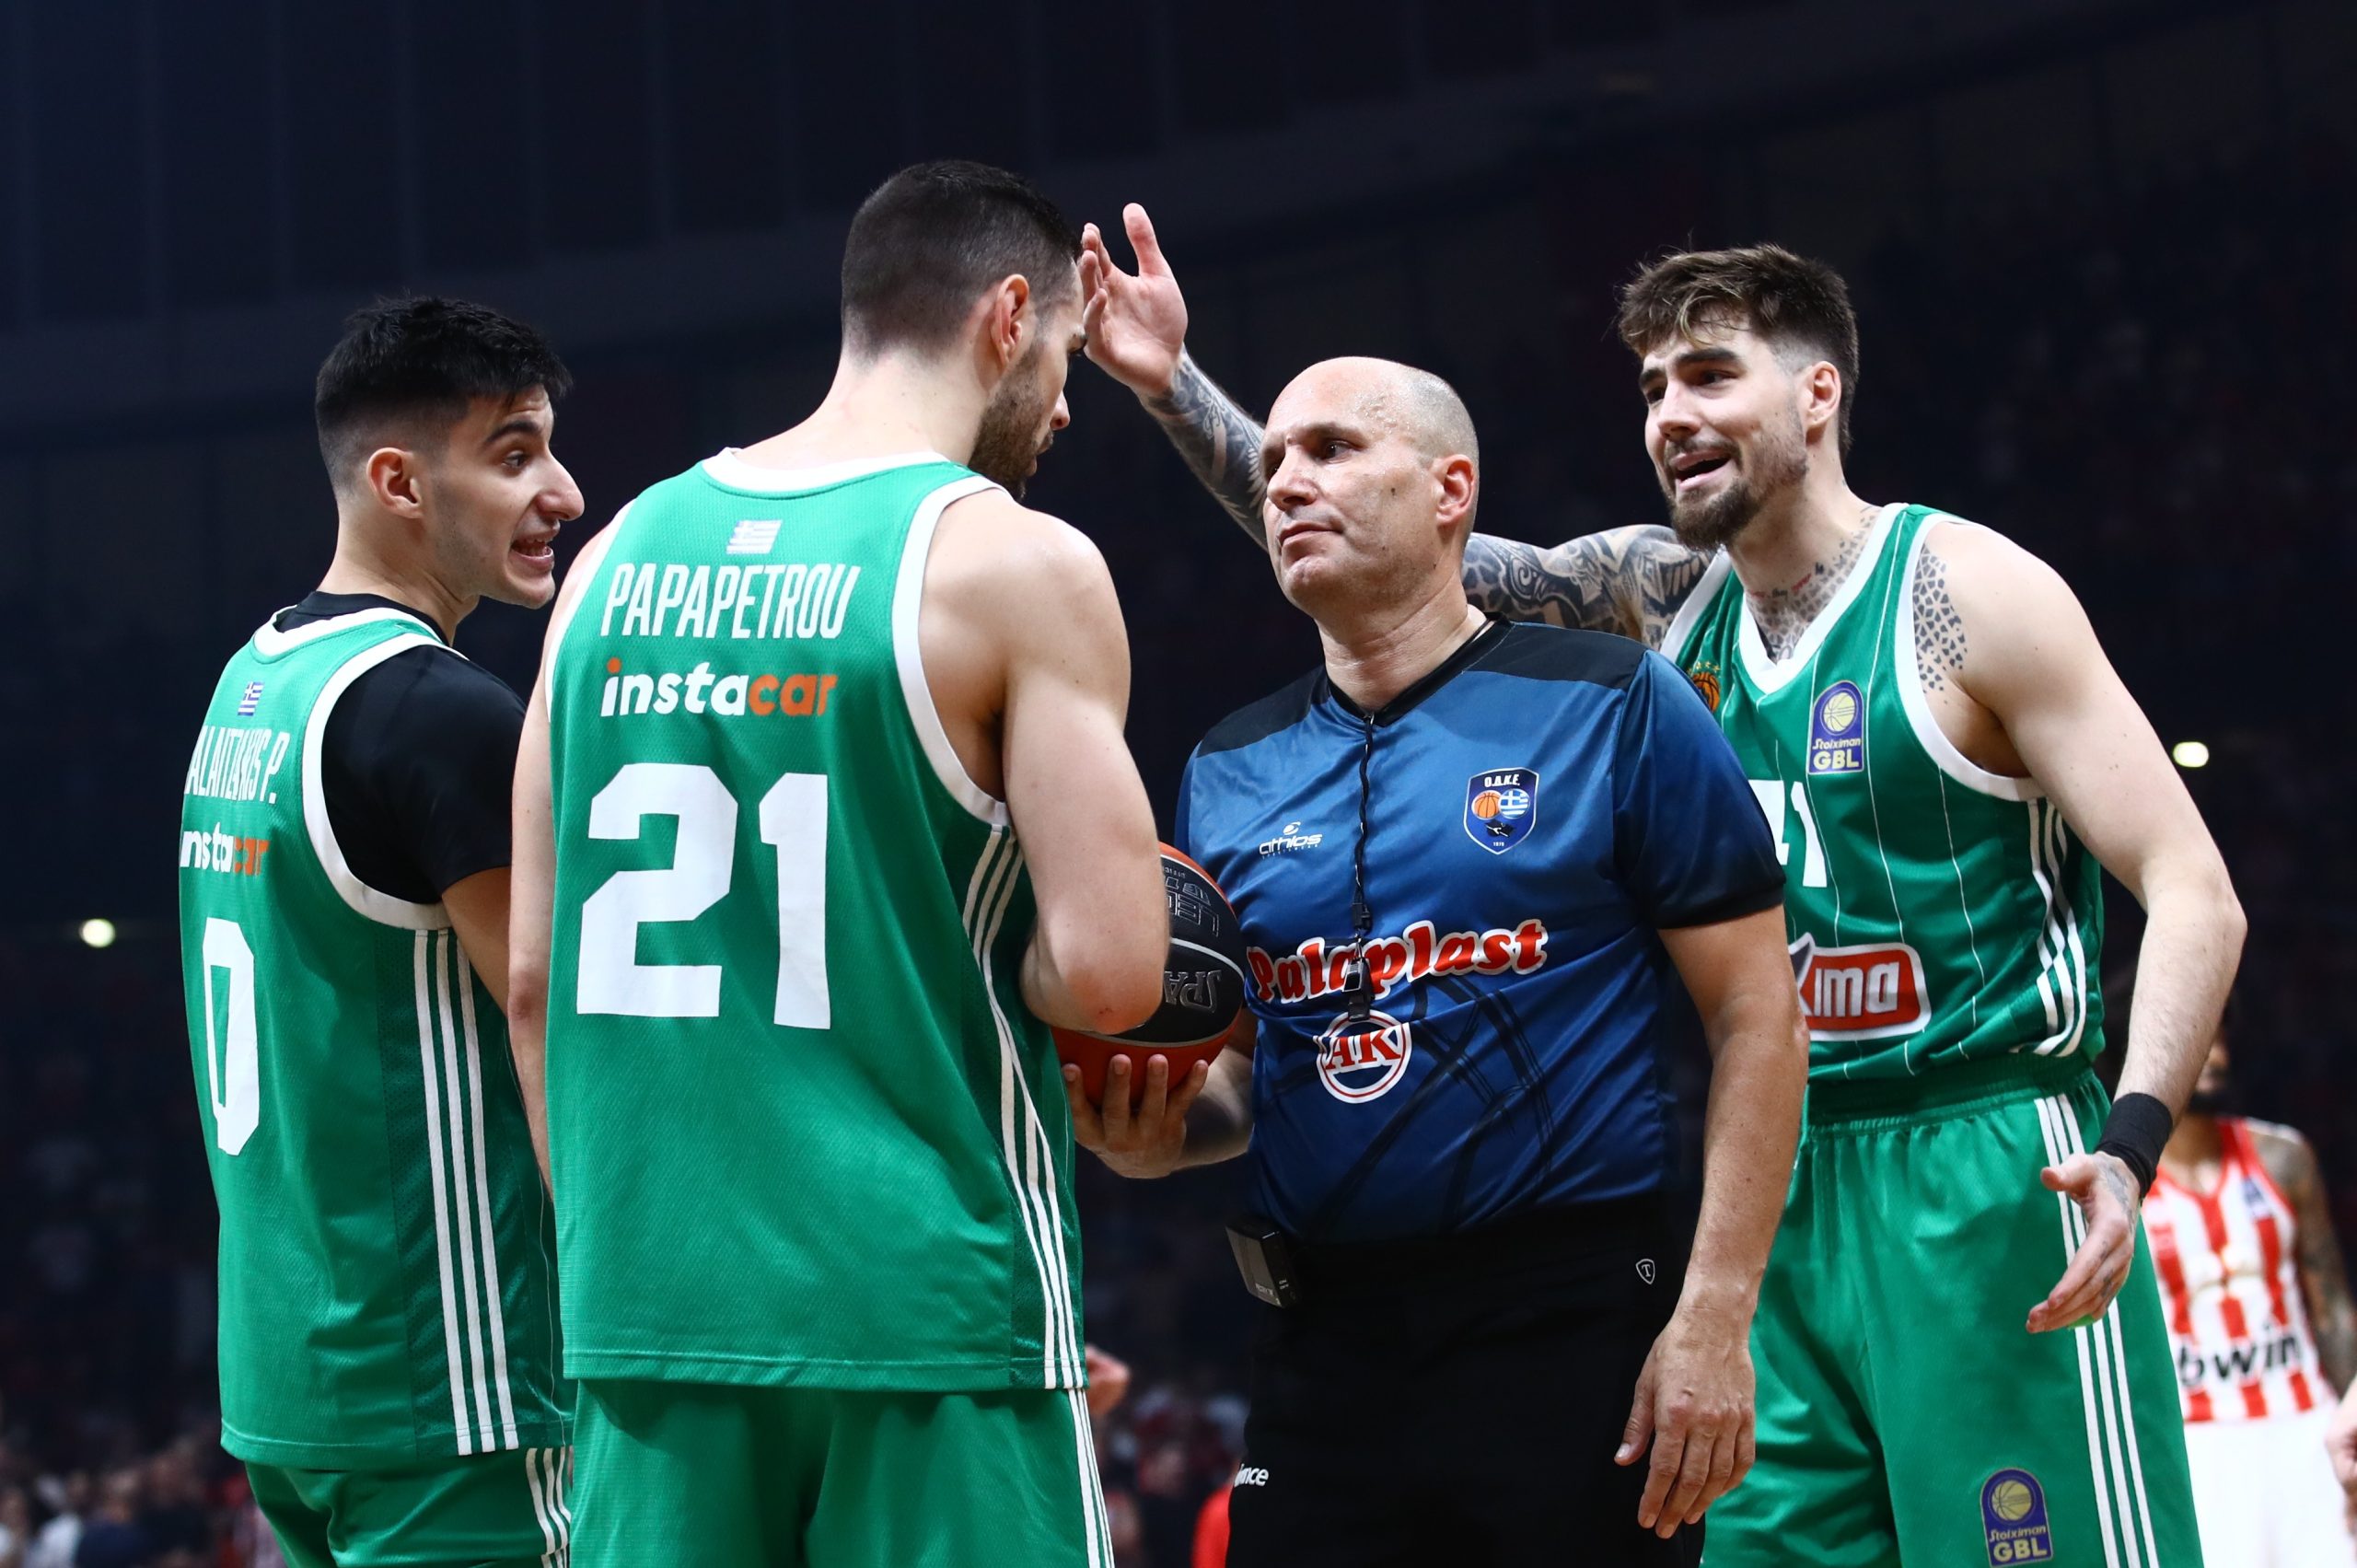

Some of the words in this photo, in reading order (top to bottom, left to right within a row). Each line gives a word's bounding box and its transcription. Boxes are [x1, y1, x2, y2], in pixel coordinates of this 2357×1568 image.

[600, 563, 861, 639] PAPAPETROU
[600, 656, 838, 717] instacar
[260, 731, 290, 805] P.
[1813, 749, 1859, 771] GBL
[576, 762, 830, 1029] 21
[1247, 919, 1549, 1004] Palaplast
[203, 917, 260, 1156] 0
[2178, 1322, 2302, 1386] bwin
[1993, 1537, 2048, 1562] GBL
